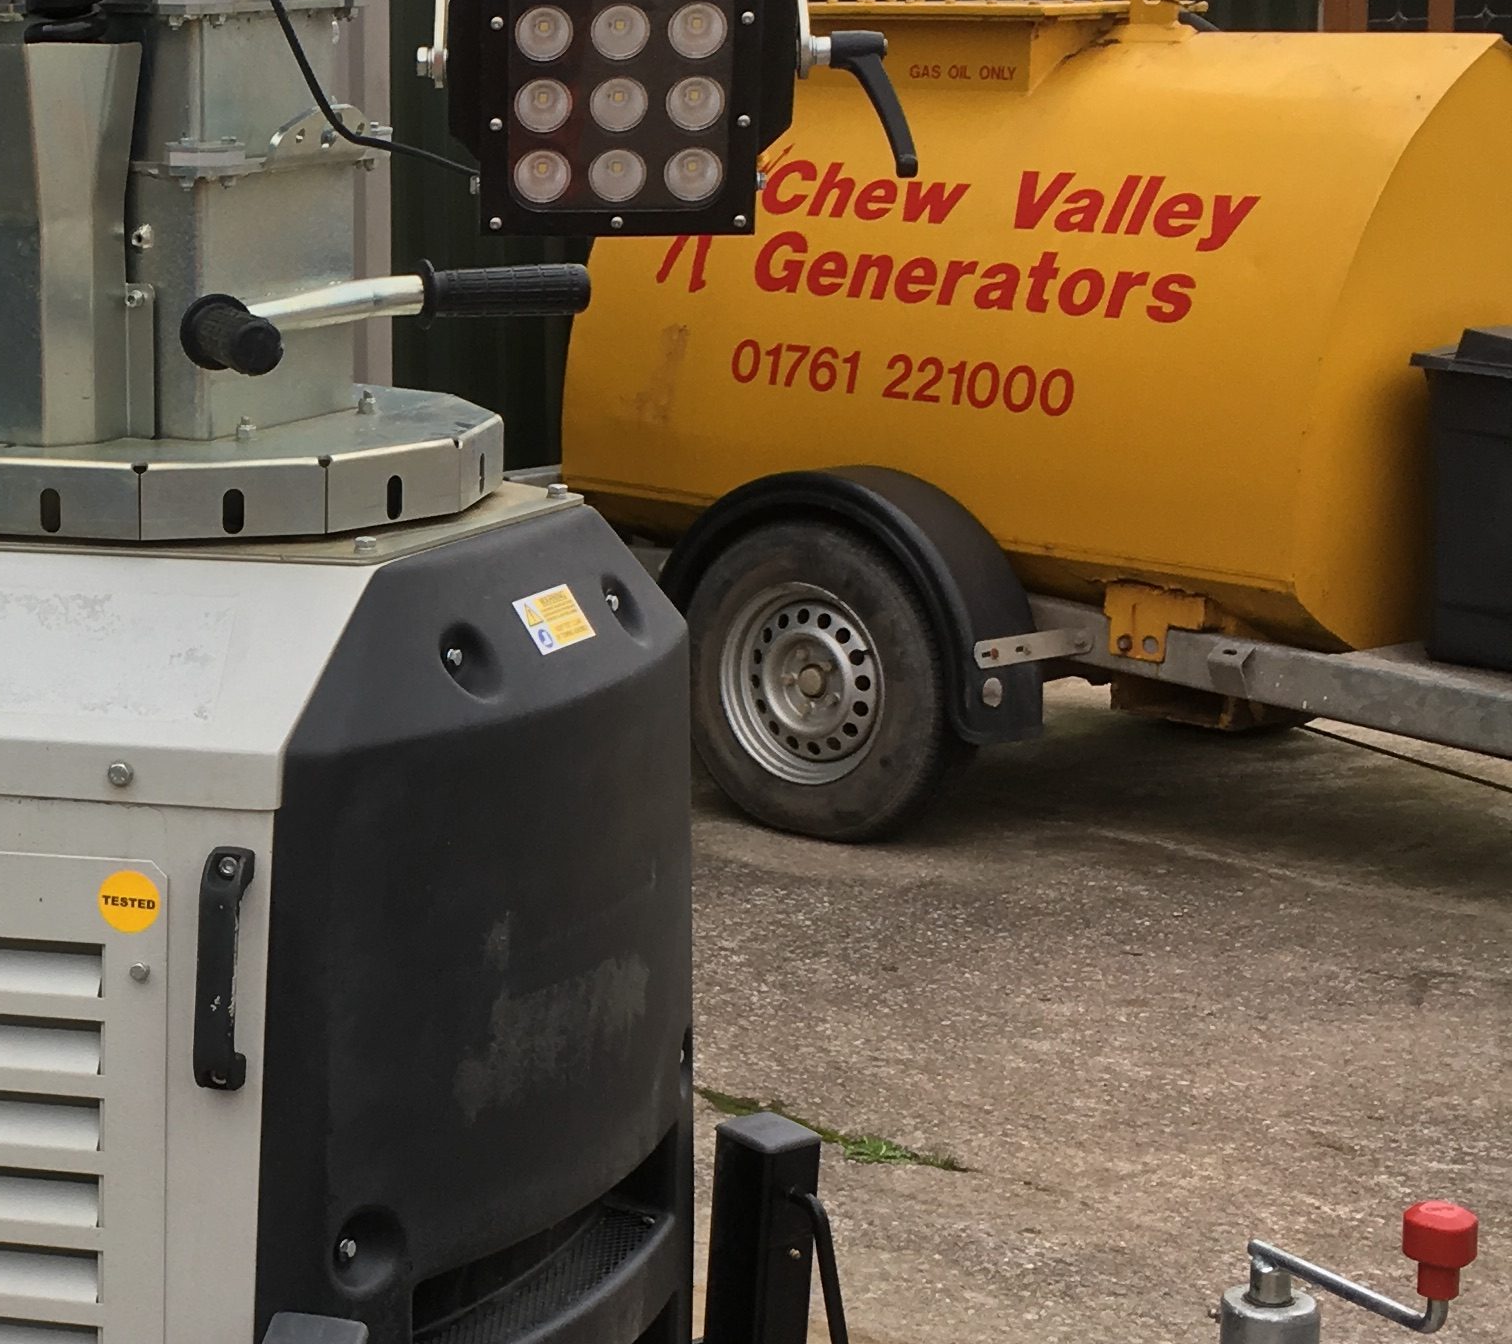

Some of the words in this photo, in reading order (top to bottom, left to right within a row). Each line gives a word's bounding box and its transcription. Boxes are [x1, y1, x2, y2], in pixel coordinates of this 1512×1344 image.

[909, 64, 941, 79] GAS
[948, 65, 971, 80] OIL
[979, 65, 1016, 80] ONLY
[761, 159, 971, 224] Chew
[1013, 170, 1261, 252] Valley
[754, 230, 1196, 323] Generators
[731, 339, 861, 394] 01761
[881, 353, 1074, 416] 221000
[101, 895, 156, 910] TESTED
